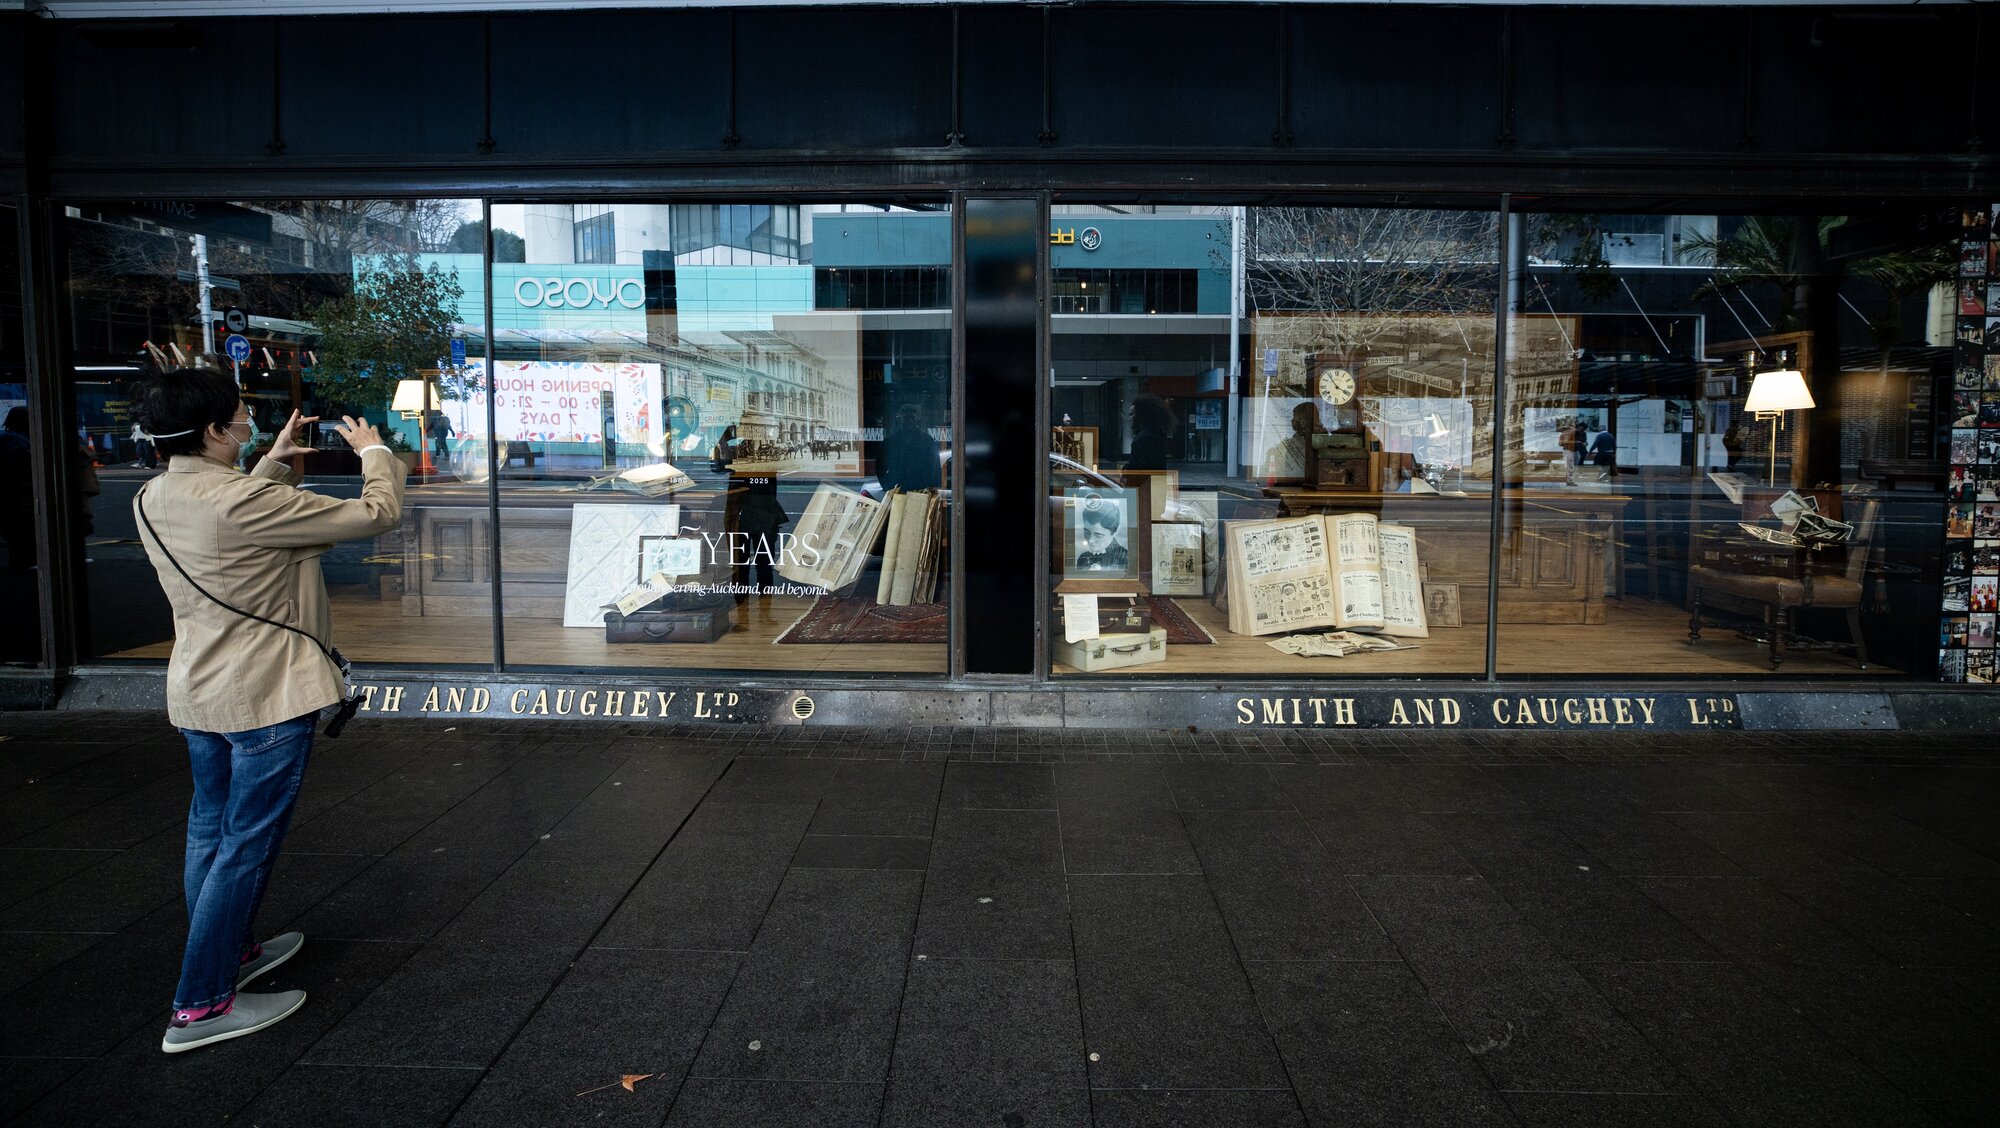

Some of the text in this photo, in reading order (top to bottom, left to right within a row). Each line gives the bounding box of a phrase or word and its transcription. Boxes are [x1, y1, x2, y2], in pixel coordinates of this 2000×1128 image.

[700, 531, 821, 567] YEARS
[706, 581, 761, 595] Auckland,
[763, 582, 785, 595] and
[787, 582, 829, 598] beyond.
[420, 686, 491, 713] AND
[510, 688, 676, 718] CAUGHEY
[1236, 698, 1358, 725] SMITH
[1389, 698, 1462, 725] AND
[1492, 698, 1656, 725] CAUGHEY
